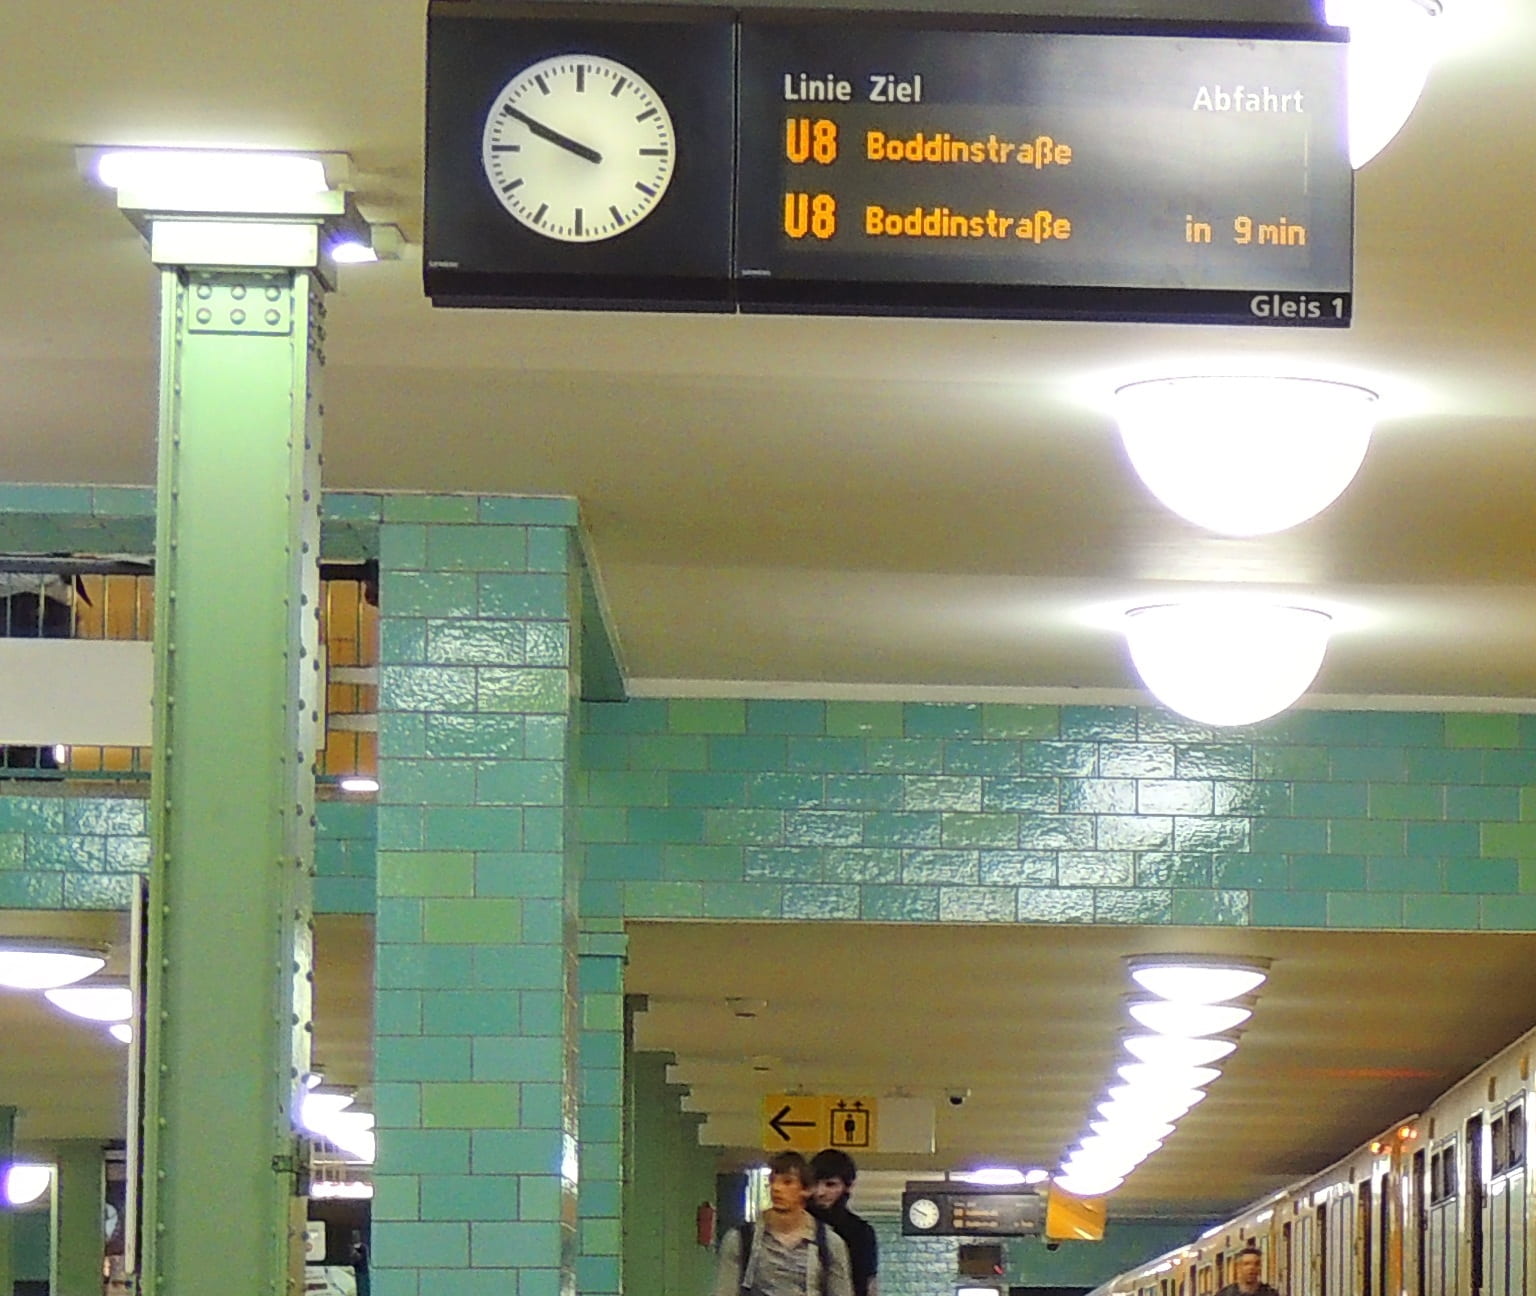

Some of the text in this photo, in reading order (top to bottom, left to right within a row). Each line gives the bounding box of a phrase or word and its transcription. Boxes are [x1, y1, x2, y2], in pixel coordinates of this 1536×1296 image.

[784, 73, 921, 104] Linie Ziel
[1192, 84, 1304, 113] Abfahrt
[786, 118, 1073, 170] U8 Boddinstraße
[785, 193, 836, 240] U8
[866, 206, 1072, 246] Boddinstraße
[1185, 214, 1213, 244] in
[1250, 294, 1344, 319] Gleis 1
